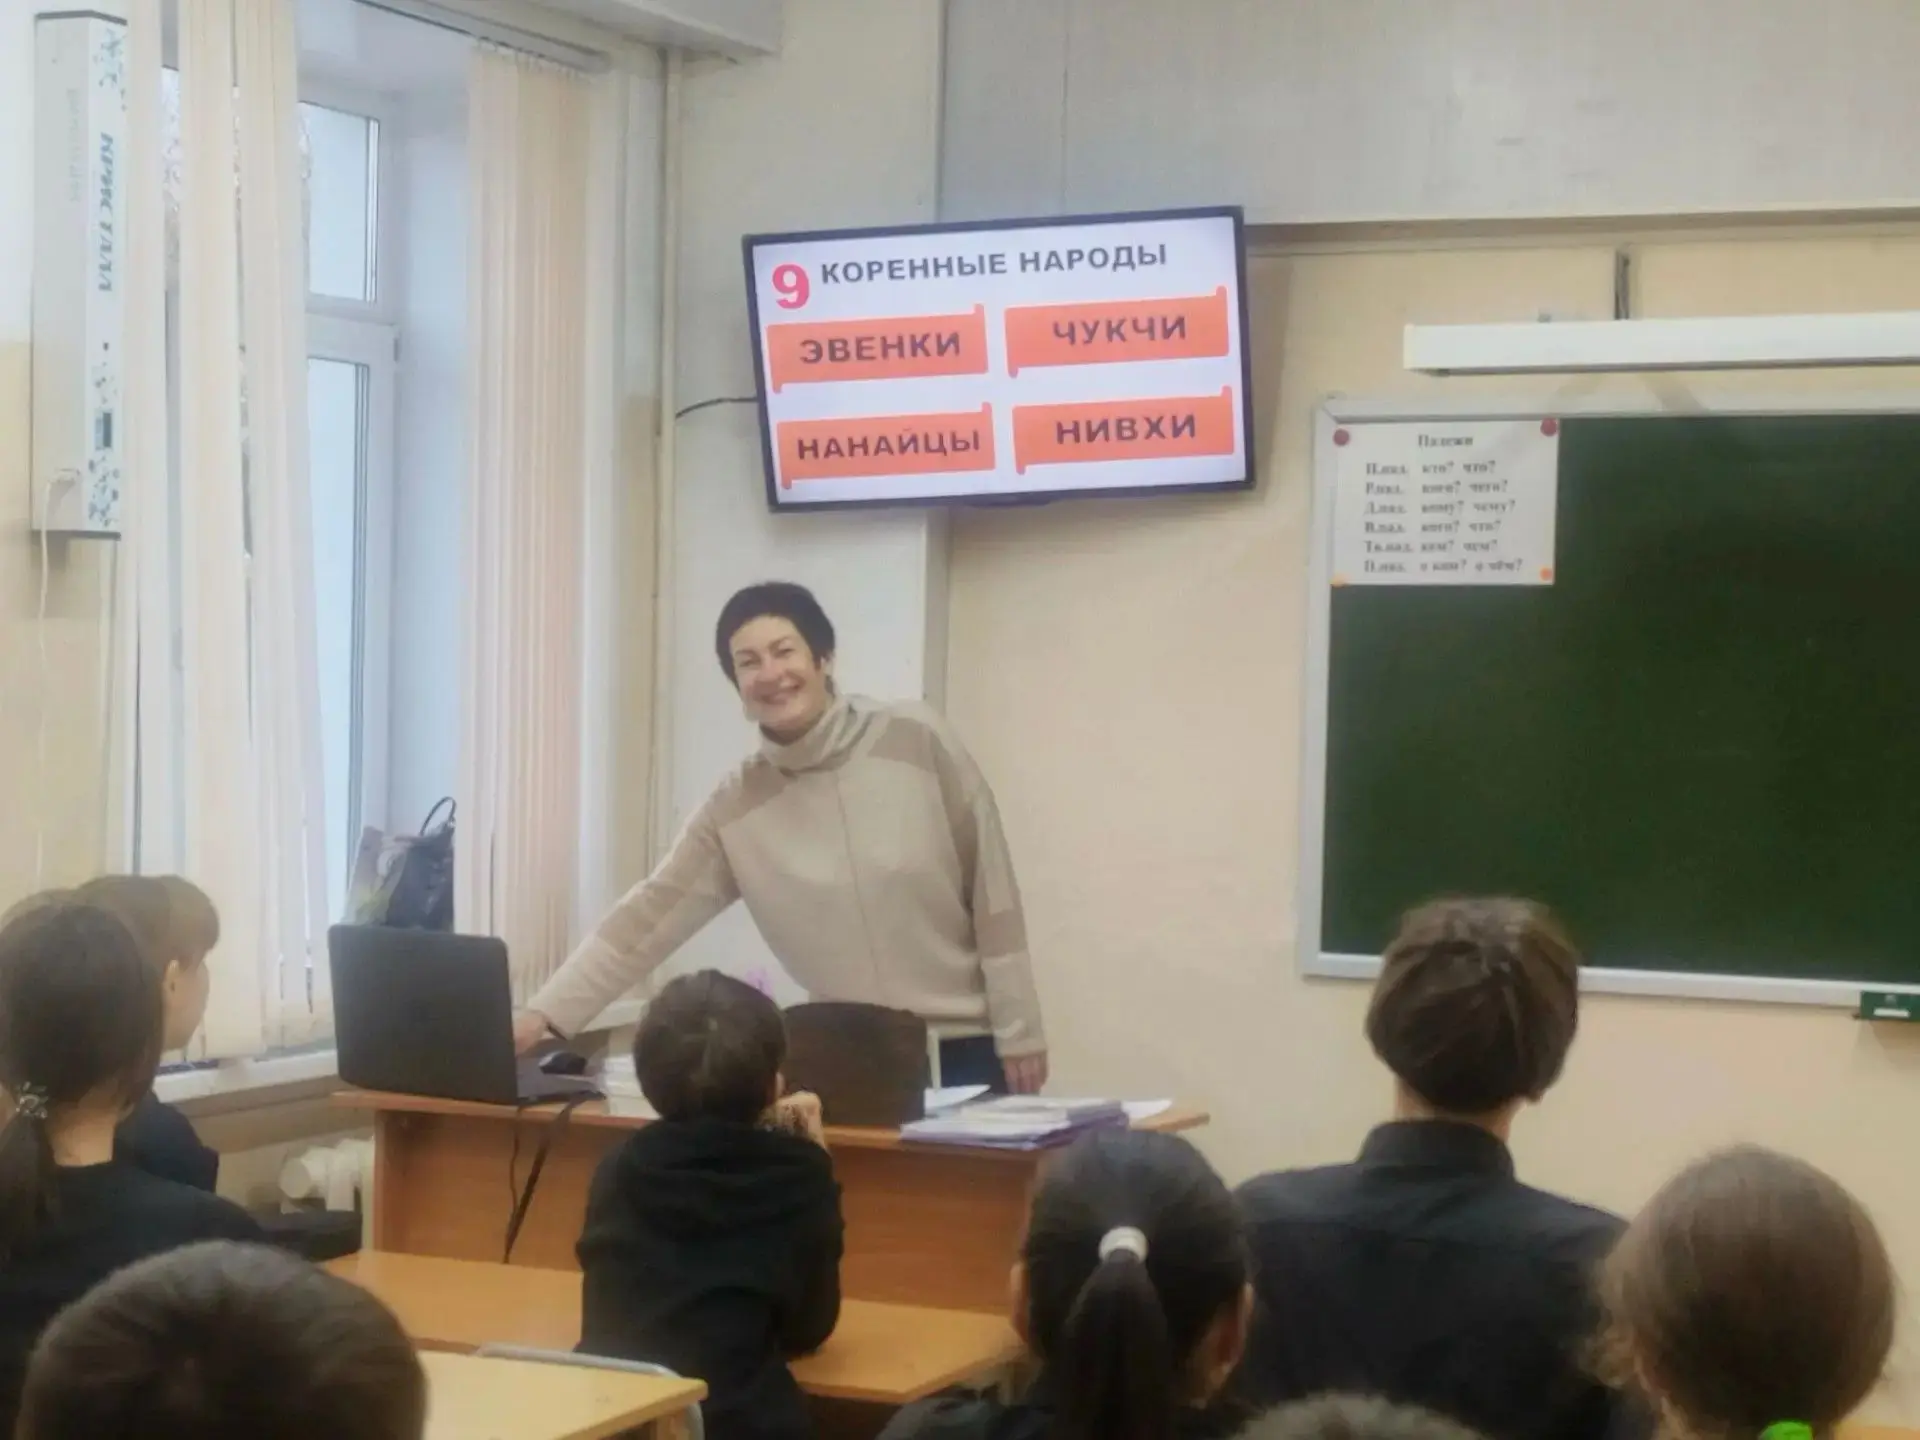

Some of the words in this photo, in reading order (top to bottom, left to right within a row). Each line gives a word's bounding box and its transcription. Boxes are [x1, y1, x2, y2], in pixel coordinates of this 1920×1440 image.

[98, 131, 114, 291] КРИСТАЛЛ
[821, 253, 1007, 284] КОРЕННЫЕ
[1019, 243, 1168, 275] НАРОДЫ
[771, 263, 811, 309] 9
[1053, 315, 1187, 345] ЧУКЧИ
[799, 331, 961, 365] ЭВЕНКИ
[797, 428, 981, 461] НАНАЙЦЫ
[1056, 414, 1197, 445] НИВХИ
[1463, 460, 1496, 474] что?
